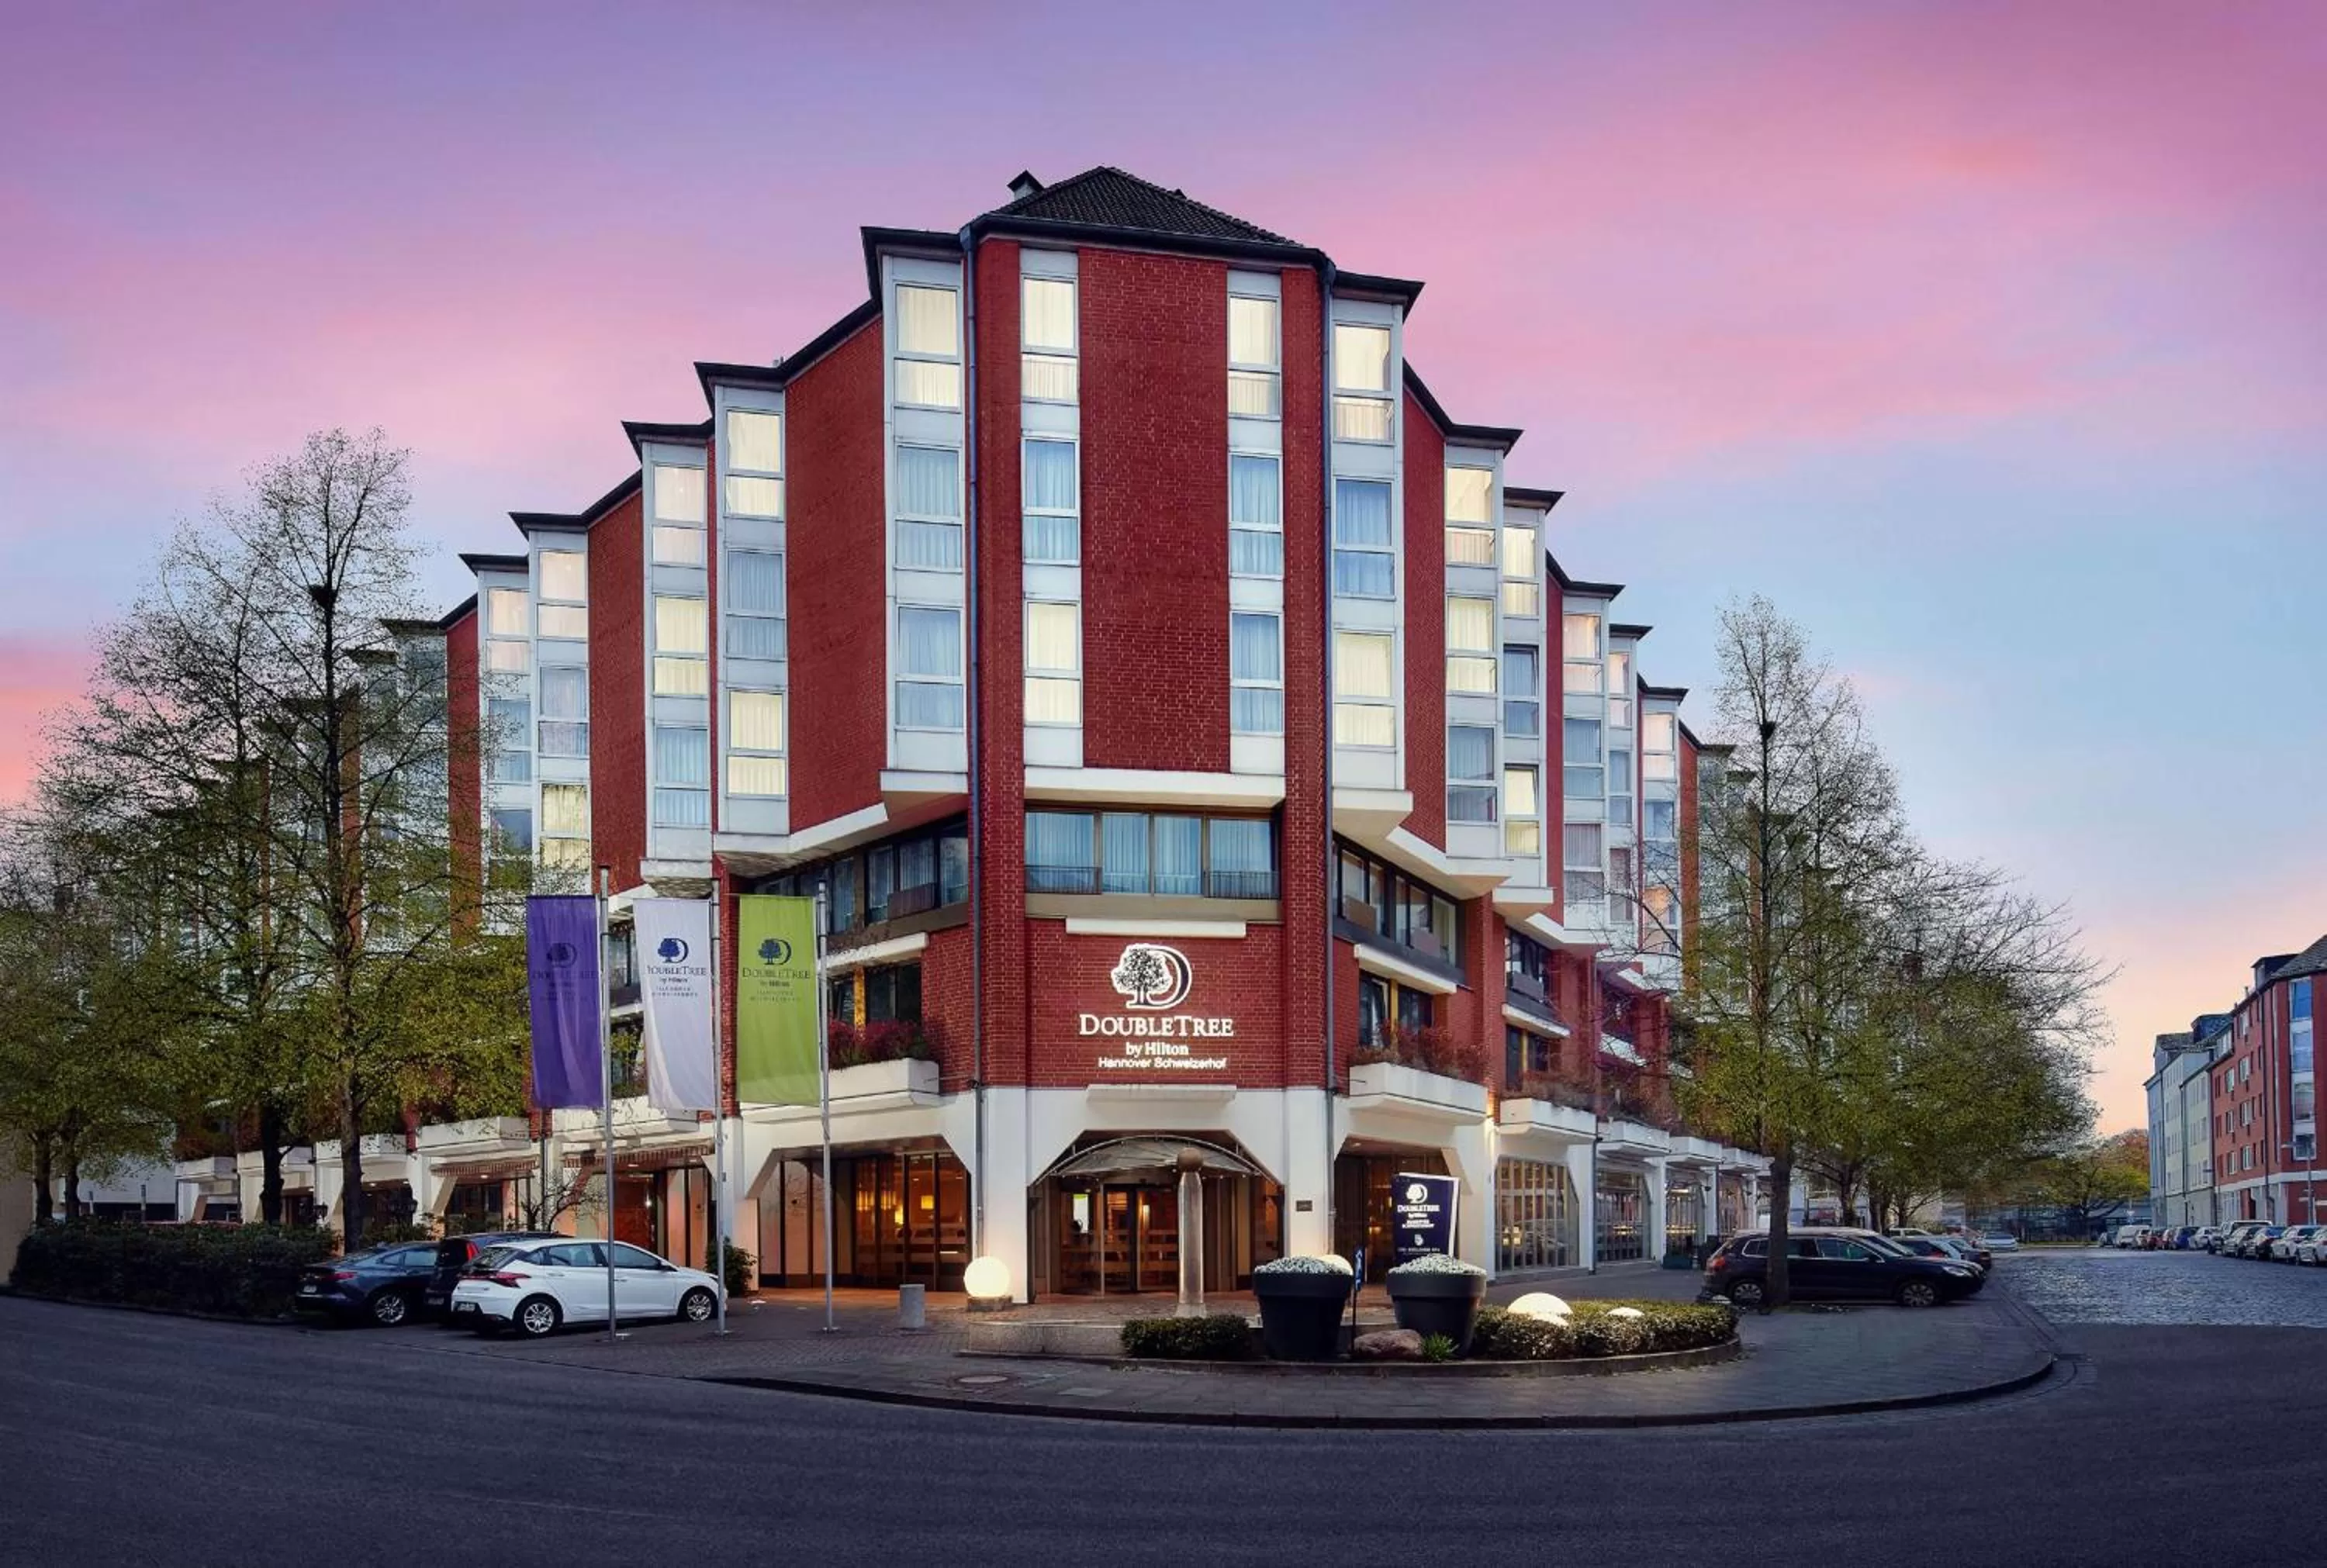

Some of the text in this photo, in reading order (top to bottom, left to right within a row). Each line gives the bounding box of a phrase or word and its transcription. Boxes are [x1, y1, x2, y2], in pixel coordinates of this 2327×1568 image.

[1079, 1014, 1234, 1037] DOUBLETREE
[1125, 1041, 1189, 1058] by Hilton
[1098, 1057, 1227, 1069] Hannover Schweizerhof
